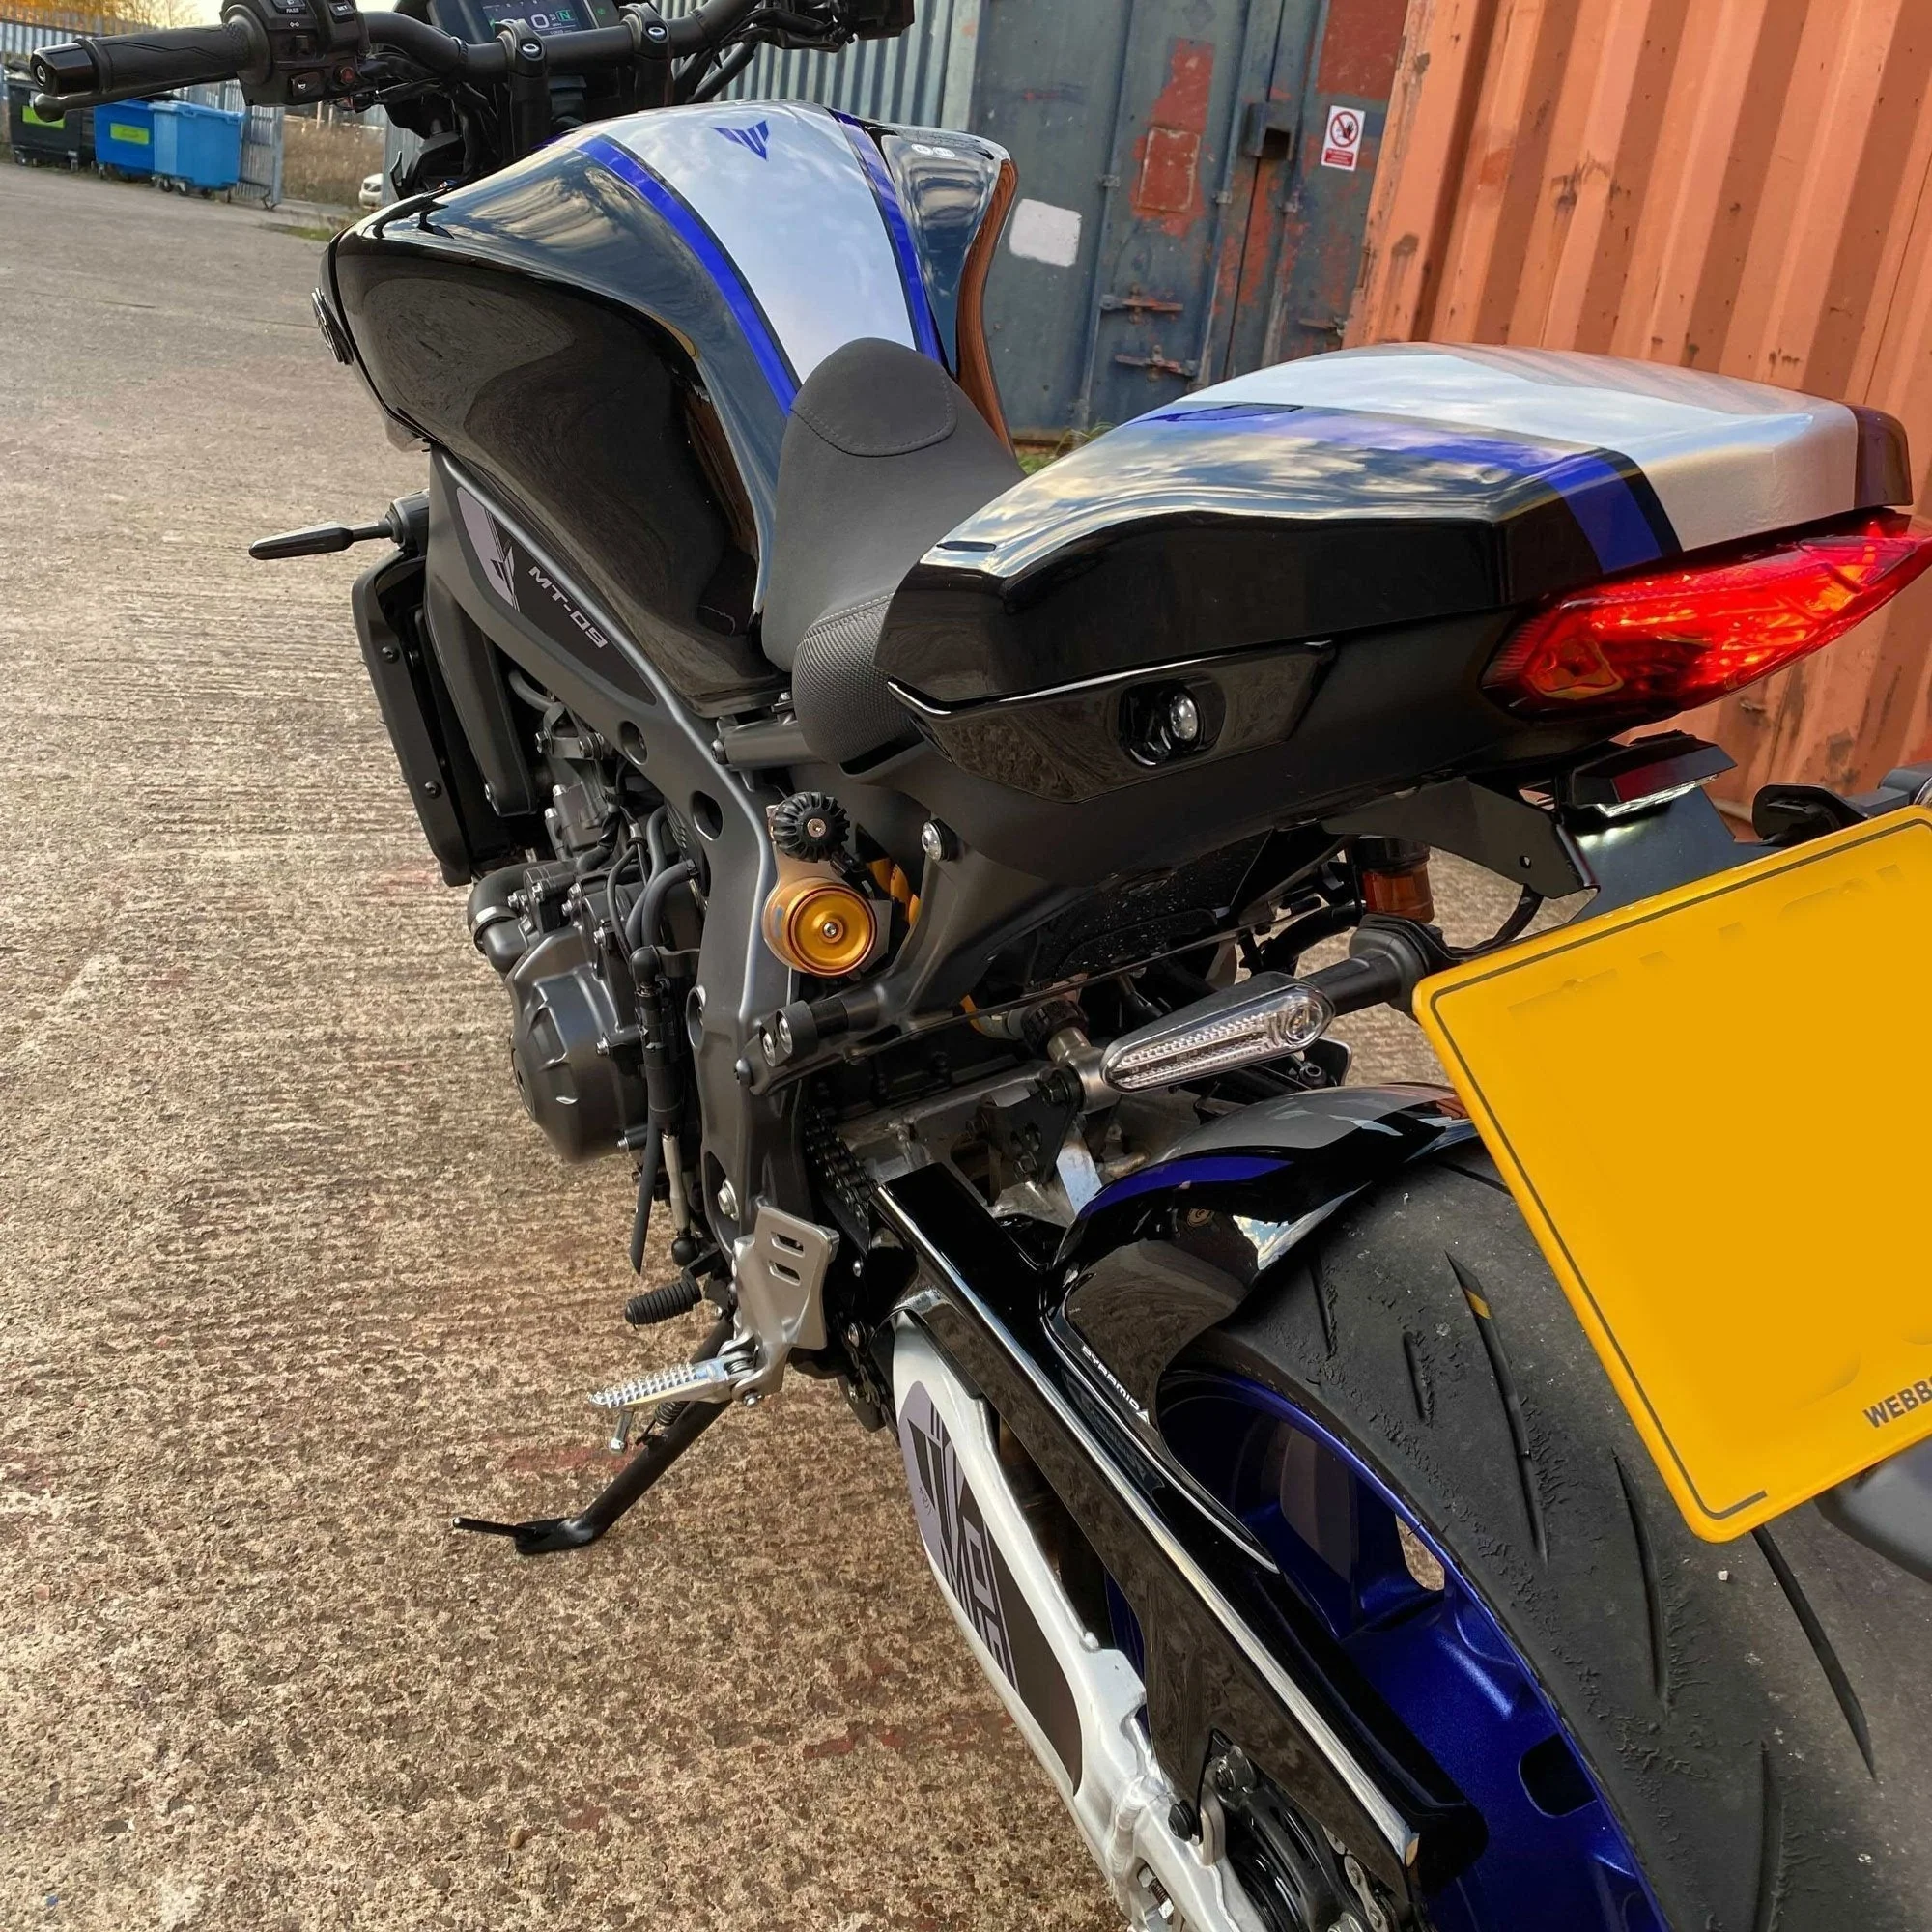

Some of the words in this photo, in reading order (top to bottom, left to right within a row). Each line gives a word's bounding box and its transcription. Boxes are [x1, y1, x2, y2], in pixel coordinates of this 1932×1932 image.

[558, 10, 571, 20] N
[528, 566, 608, 648] MT-09
[1082, 1345, 1140, 1411] PYRAMID
[1862, 1375, 1932, 1428] WEBB
